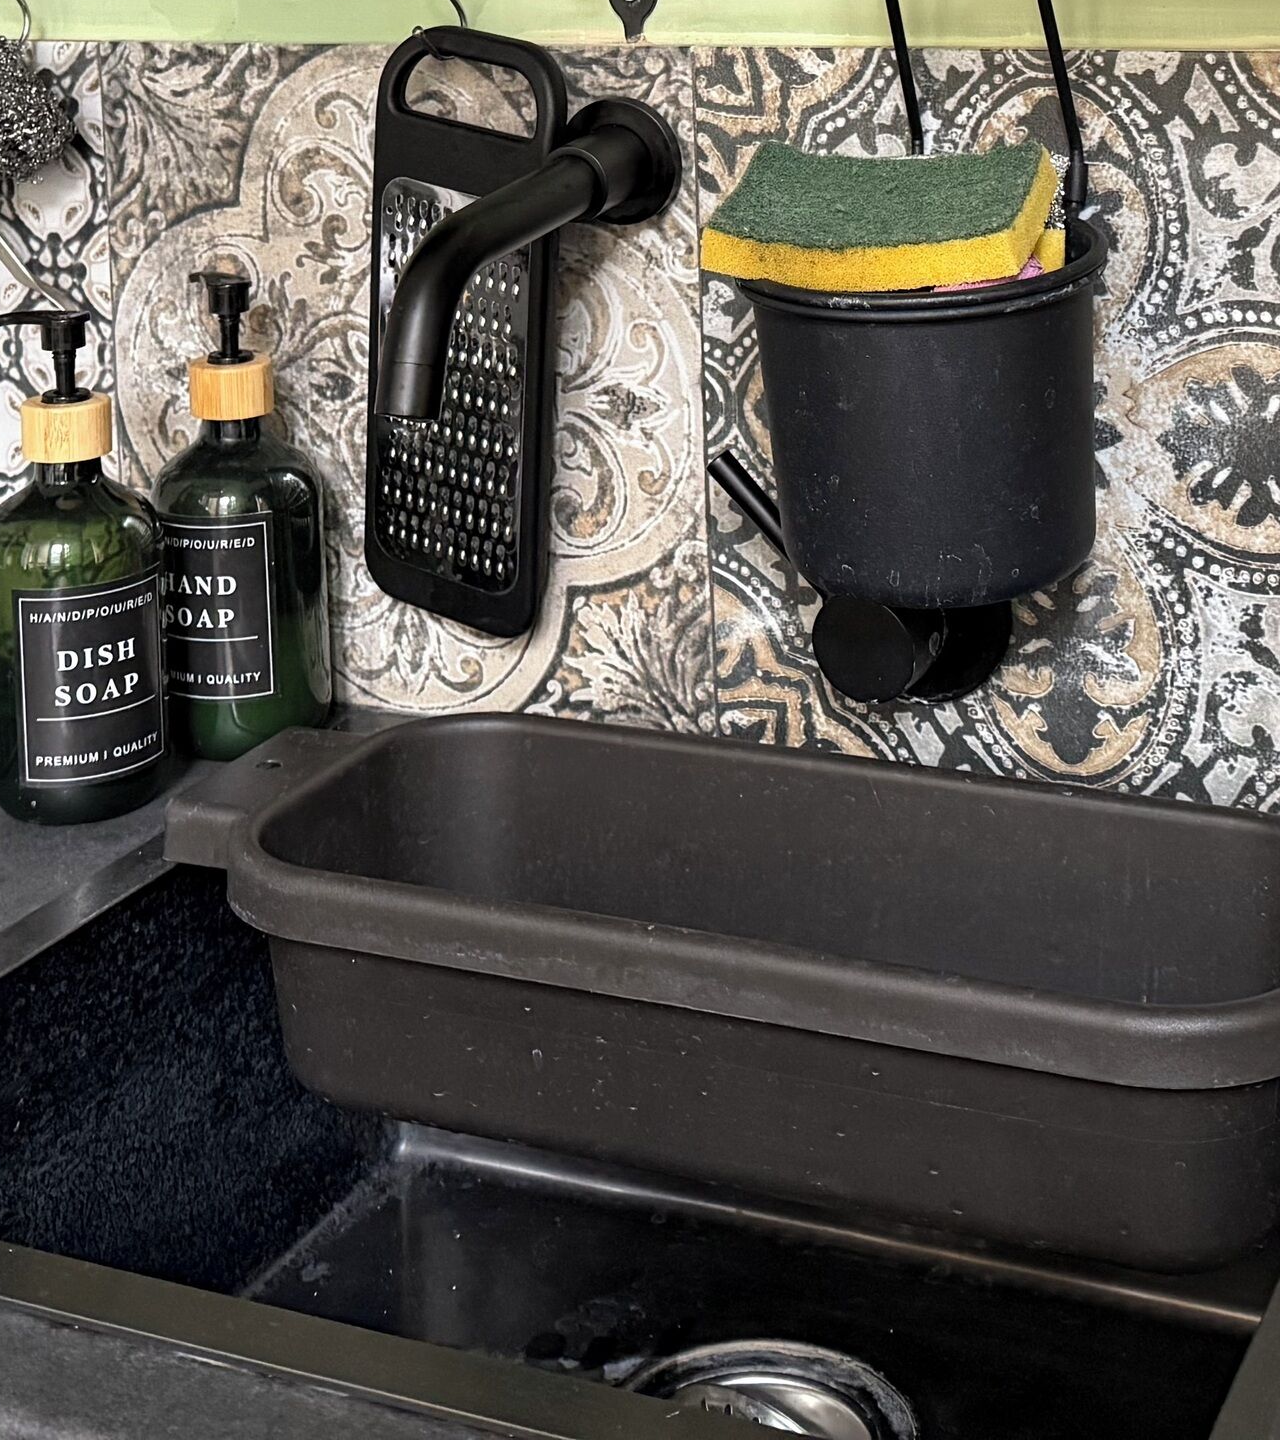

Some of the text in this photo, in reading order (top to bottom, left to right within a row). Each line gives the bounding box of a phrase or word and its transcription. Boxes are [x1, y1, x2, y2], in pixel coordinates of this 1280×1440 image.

[164, 572, 237, 596] HAND
[29, 592, 153, 624] H/A/N/D/P/O/U/R/E/D
[165, 604, 235, 628] SOAP
[56, 637, 136, 672] DISH
[54, 672, 139, 707] SOAP
[207, 671, 261, 685] QUALITY
[35, 751, 99, 767] PREMIUM
[113, 731, 159, 758] QUALITY
